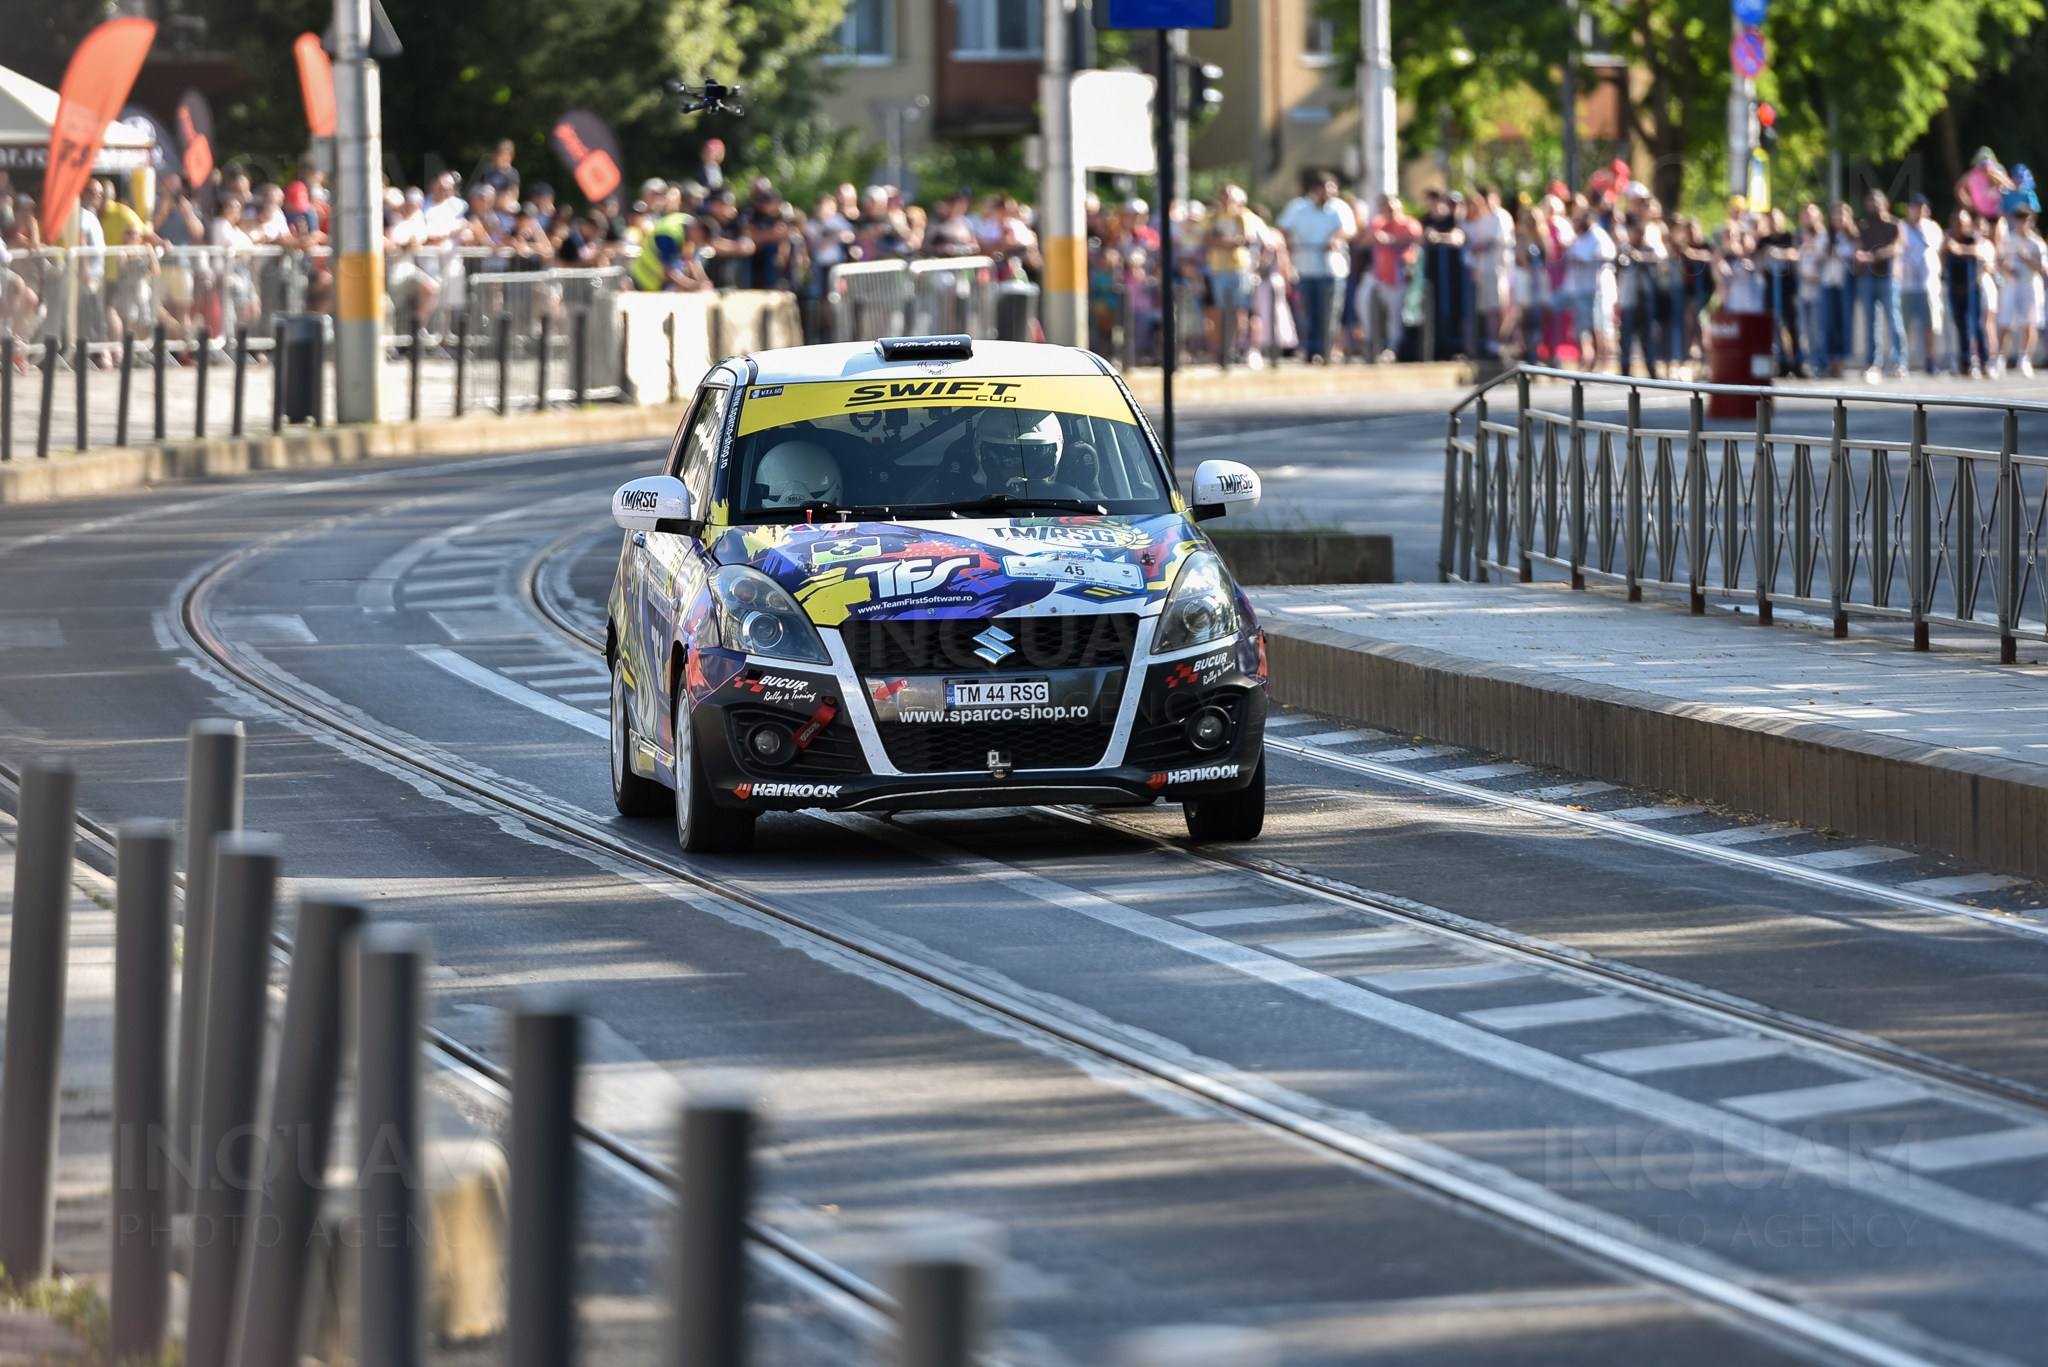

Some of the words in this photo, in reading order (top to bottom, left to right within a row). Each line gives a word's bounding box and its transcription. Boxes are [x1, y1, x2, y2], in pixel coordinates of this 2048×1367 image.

[848, 381, 1022, 402] SWIFT
[720, 386, 743, 470] www.sparco-shop.ro
[854, 557, 971, 599] TFS
[1064, 565, 1086, 576] 45
[857, 594, 973, 615] www.TeamFirstSoftware.ro
[1192, 651, 1228, 673] BUCUR
[758, 675, 809, 691] BUCUR
[957, 685, 981, 702] TM
[986, 685, 1005, 701] 44
[1010, 684, 1046, 701] RSG
[763, 690, 782, 703] Rally
[791, 689, 817, 702] Tuning
[898, 704, 1089, 724] www.sparco-shop.ro
